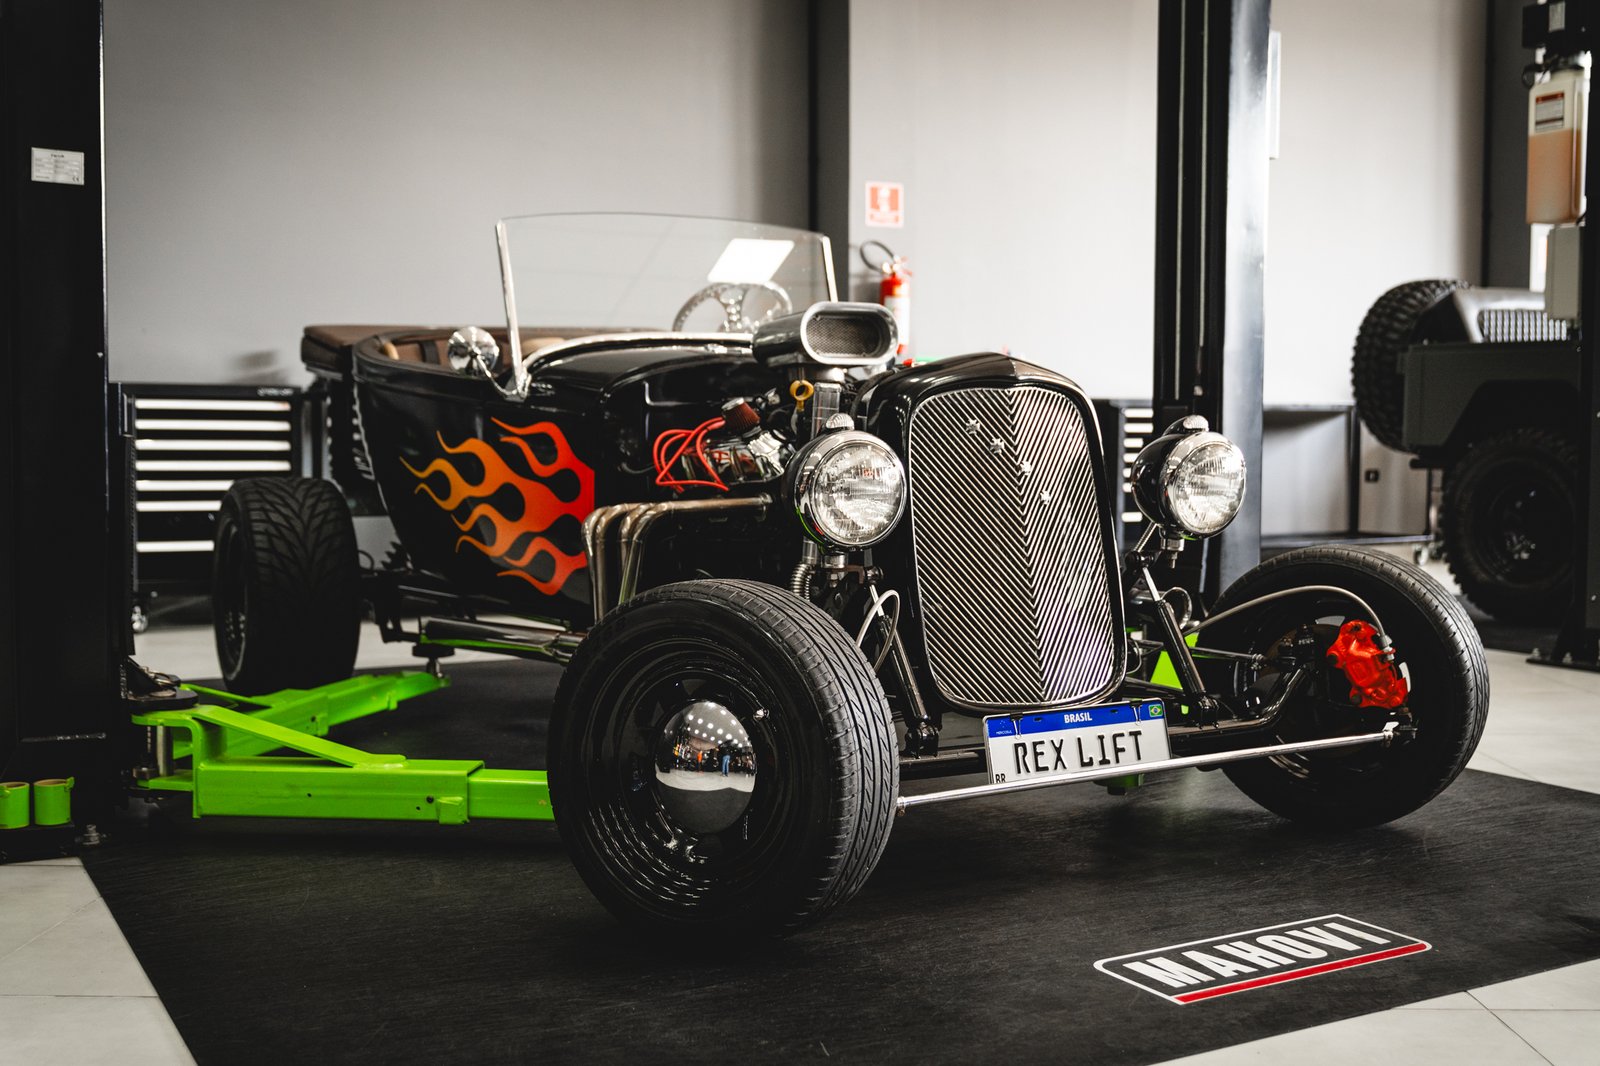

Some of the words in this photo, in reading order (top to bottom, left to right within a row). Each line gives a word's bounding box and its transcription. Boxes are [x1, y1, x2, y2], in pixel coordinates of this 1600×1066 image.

[1063, 712, 1093, 724] BRASIL
[1014, 739, 1067, 774] REX
[1077, 730, 1142, 767] LIFT
[1122, 922, 1391, 988] MAHOVI
